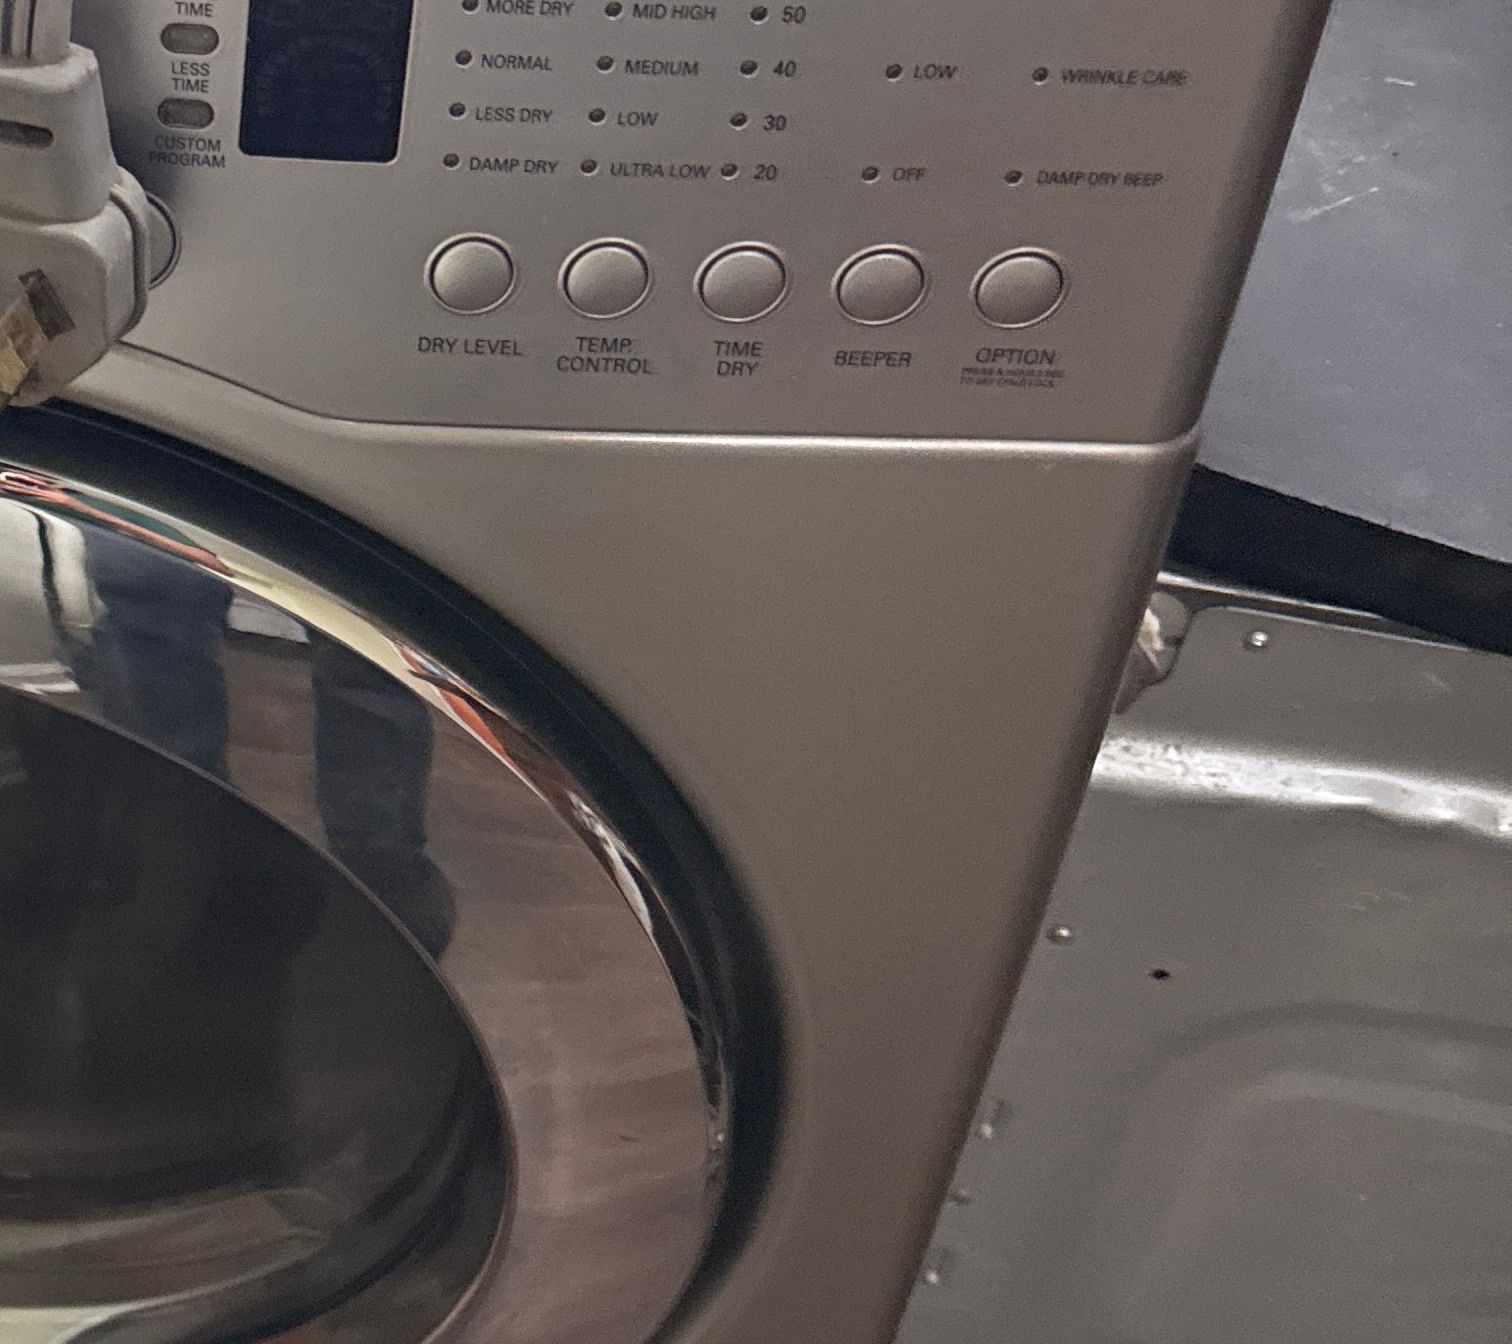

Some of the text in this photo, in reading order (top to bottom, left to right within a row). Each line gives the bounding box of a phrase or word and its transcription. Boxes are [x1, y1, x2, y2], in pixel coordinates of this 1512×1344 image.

[175, 1, 214, 18] TIME
[486, 0, 575, 18] MORE DRY
[632, 3, 718, 21] MID HIGH
[782, 6, 807, 24] 50
[171, 62, 210, 77] LESS
[480, 54, 553, 72] NORMAL
[624, 59, 700, 77] MEDIUM
[772, 60, 798, 78] 40
[913, 64, 958, 81] LOW
[1061, 67, 1139, 86] WRINKLE
[172, 78, 210, 94] TIME
[475, 106, 553, 124] LESS DRY
[617, 110, 659, 127] LOW
[763, 114, 787, 131] 30
[154, 135, 221, 152] CUSTOM
[148, 151, 226, 169] PROGRAM
[469, 157, 559, 175] DAMP DRY
[609, 162, 712, 180] ULTRA LOW
[753, 163, 778, 181] 20
[892, 167, 926, 183] OFF
[1037, 169, 1164, 187] DAMP DRY BEEP
[417, 336, 523, 356] DRY LEVEL
[713, 340, 764, 357] TIME
[834, 350, 912, 368] BEEPER
[975, 347, 1057, 365] OPTION
[556, 356, 653, 375] CONTROL
[716, 360, 760, 377] DRY
